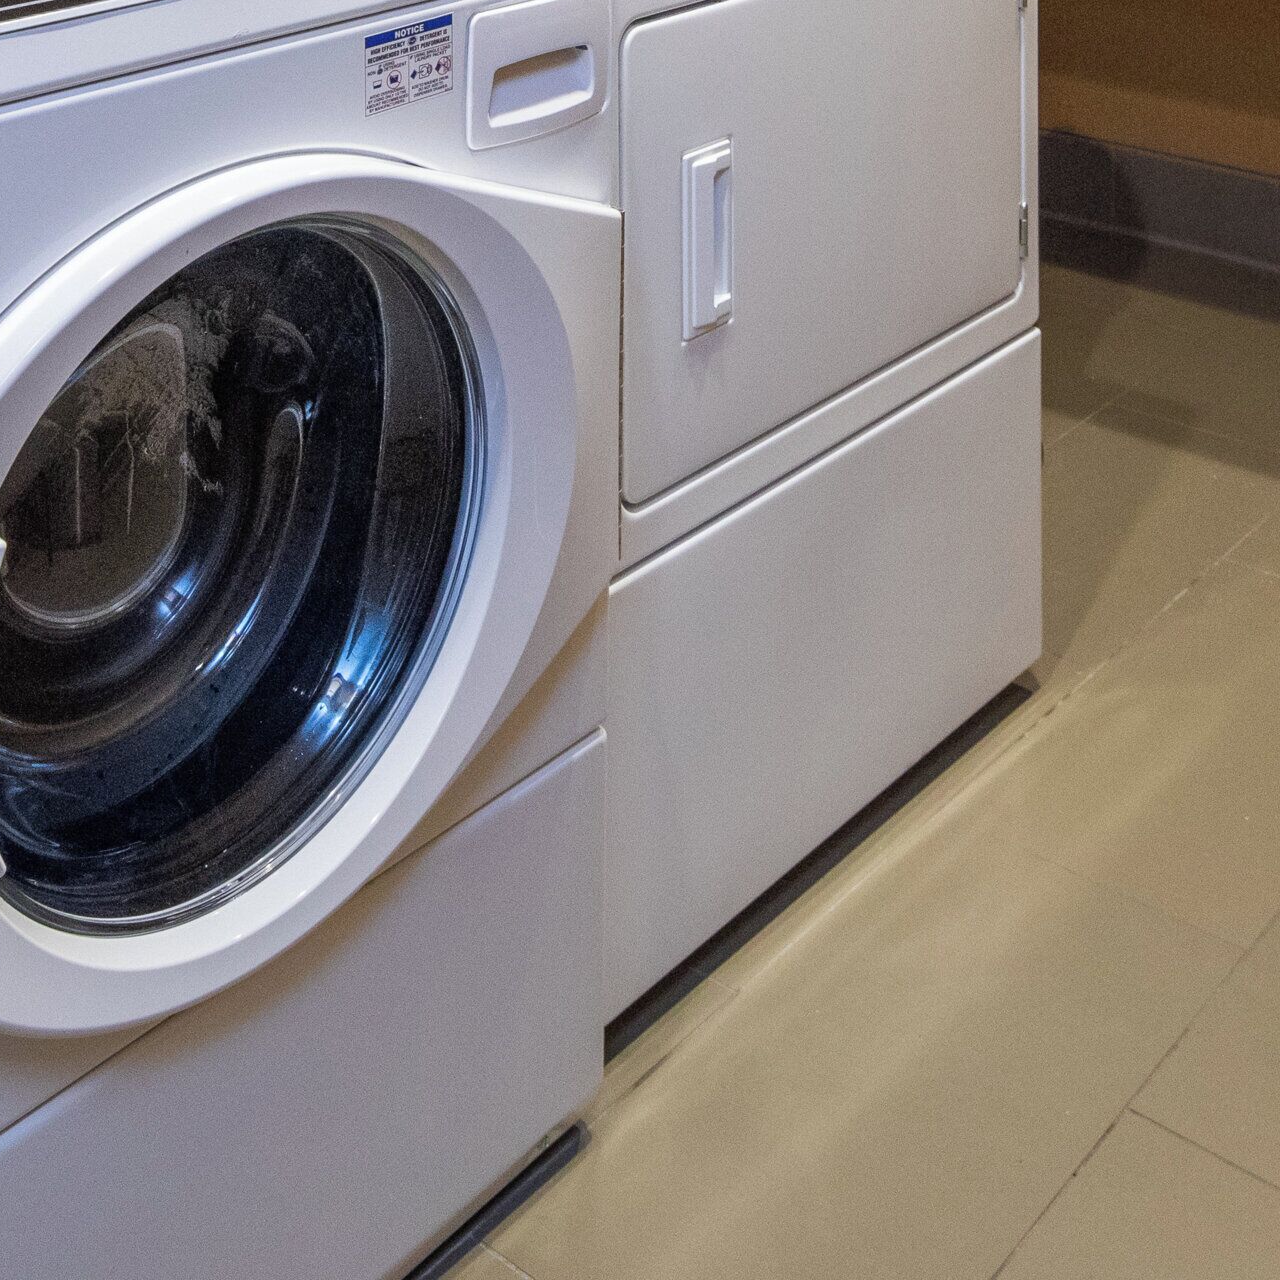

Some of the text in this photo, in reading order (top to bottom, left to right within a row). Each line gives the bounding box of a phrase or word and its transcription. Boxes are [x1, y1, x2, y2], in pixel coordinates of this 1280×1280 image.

[395, 24, 424, 38] NOTICE
[367, 50, 399, 63] RECOMMENDED
[420, 35, 449, 48] PERFORMANCE
